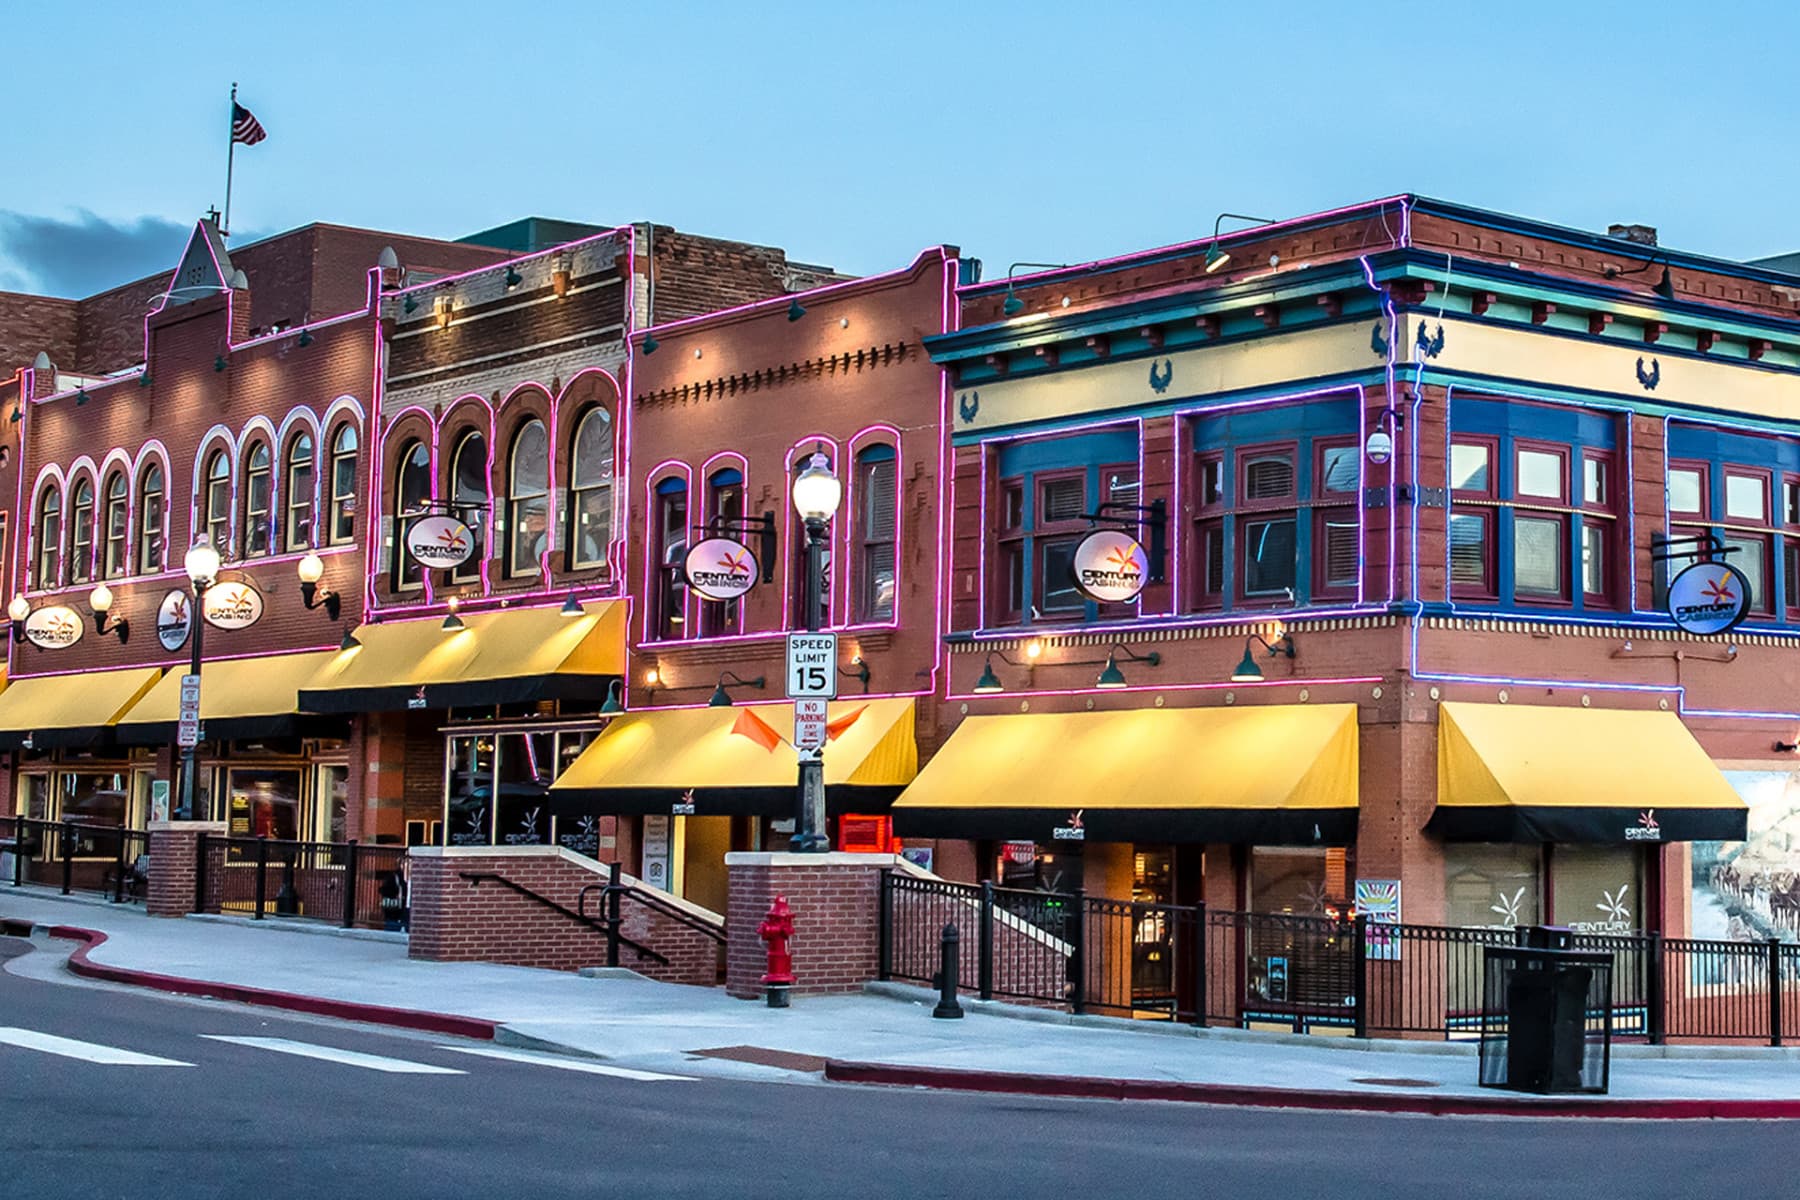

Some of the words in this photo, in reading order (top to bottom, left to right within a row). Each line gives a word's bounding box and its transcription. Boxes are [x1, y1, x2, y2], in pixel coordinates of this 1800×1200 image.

[414, 545, 467, 553] CENTURY
[693, 571, 750, 581] CENTURY
[1082, 569, 1141, 580] CENTURY
[694, 577, 749, 588] CASINOS
[1676, 603, 1736, 614] CENTURY
[792, 639, 833, 650] SPEED
[795, 653, 828, 663] LIMIT
[796, 667, 827, 690] 15
[804, 703, 818, 712] NO
[797, 713, 824, 722] PARKING
[1568, 921, 1631, 932] CENTURY
